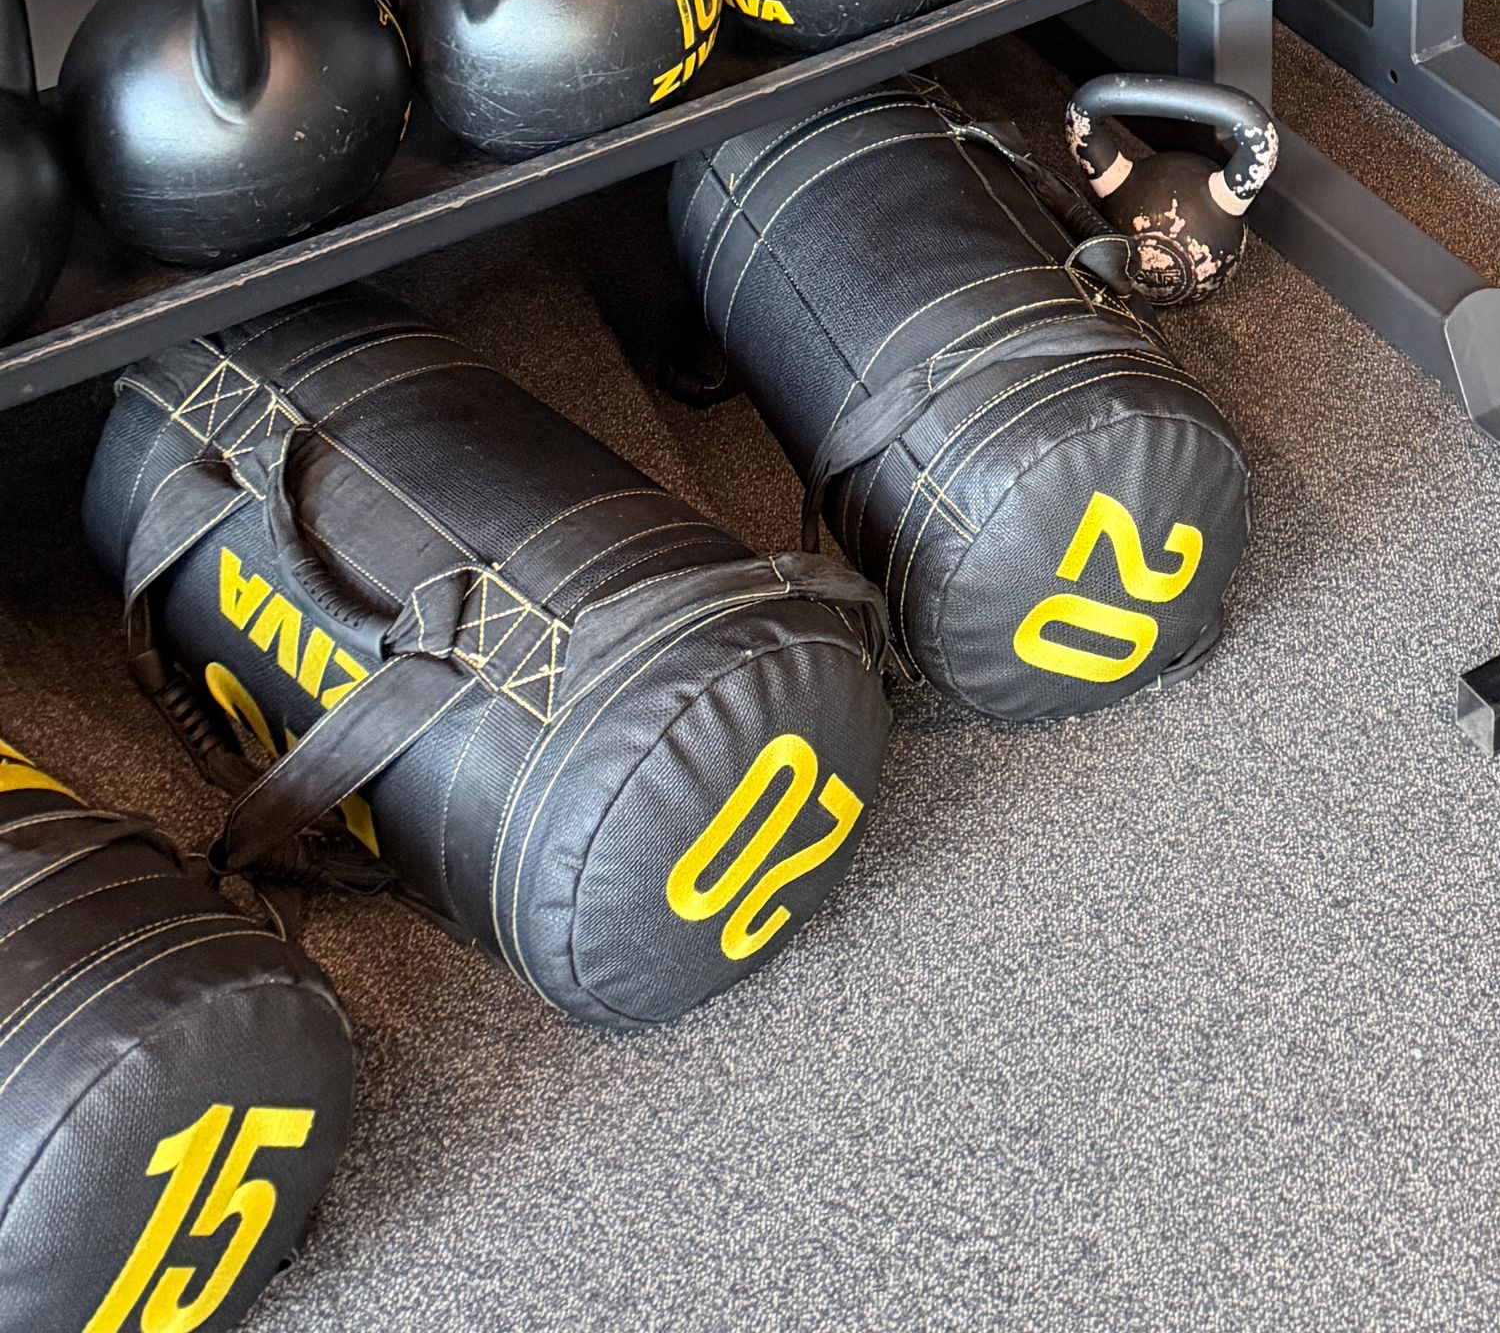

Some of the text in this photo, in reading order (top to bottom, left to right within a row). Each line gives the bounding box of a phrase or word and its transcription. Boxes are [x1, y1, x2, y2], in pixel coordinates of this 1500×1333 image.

[1013, 491, 1203, 683] 20
[666, 734, 864, 961] 20
[82, 1104, 316, 1333] 15
